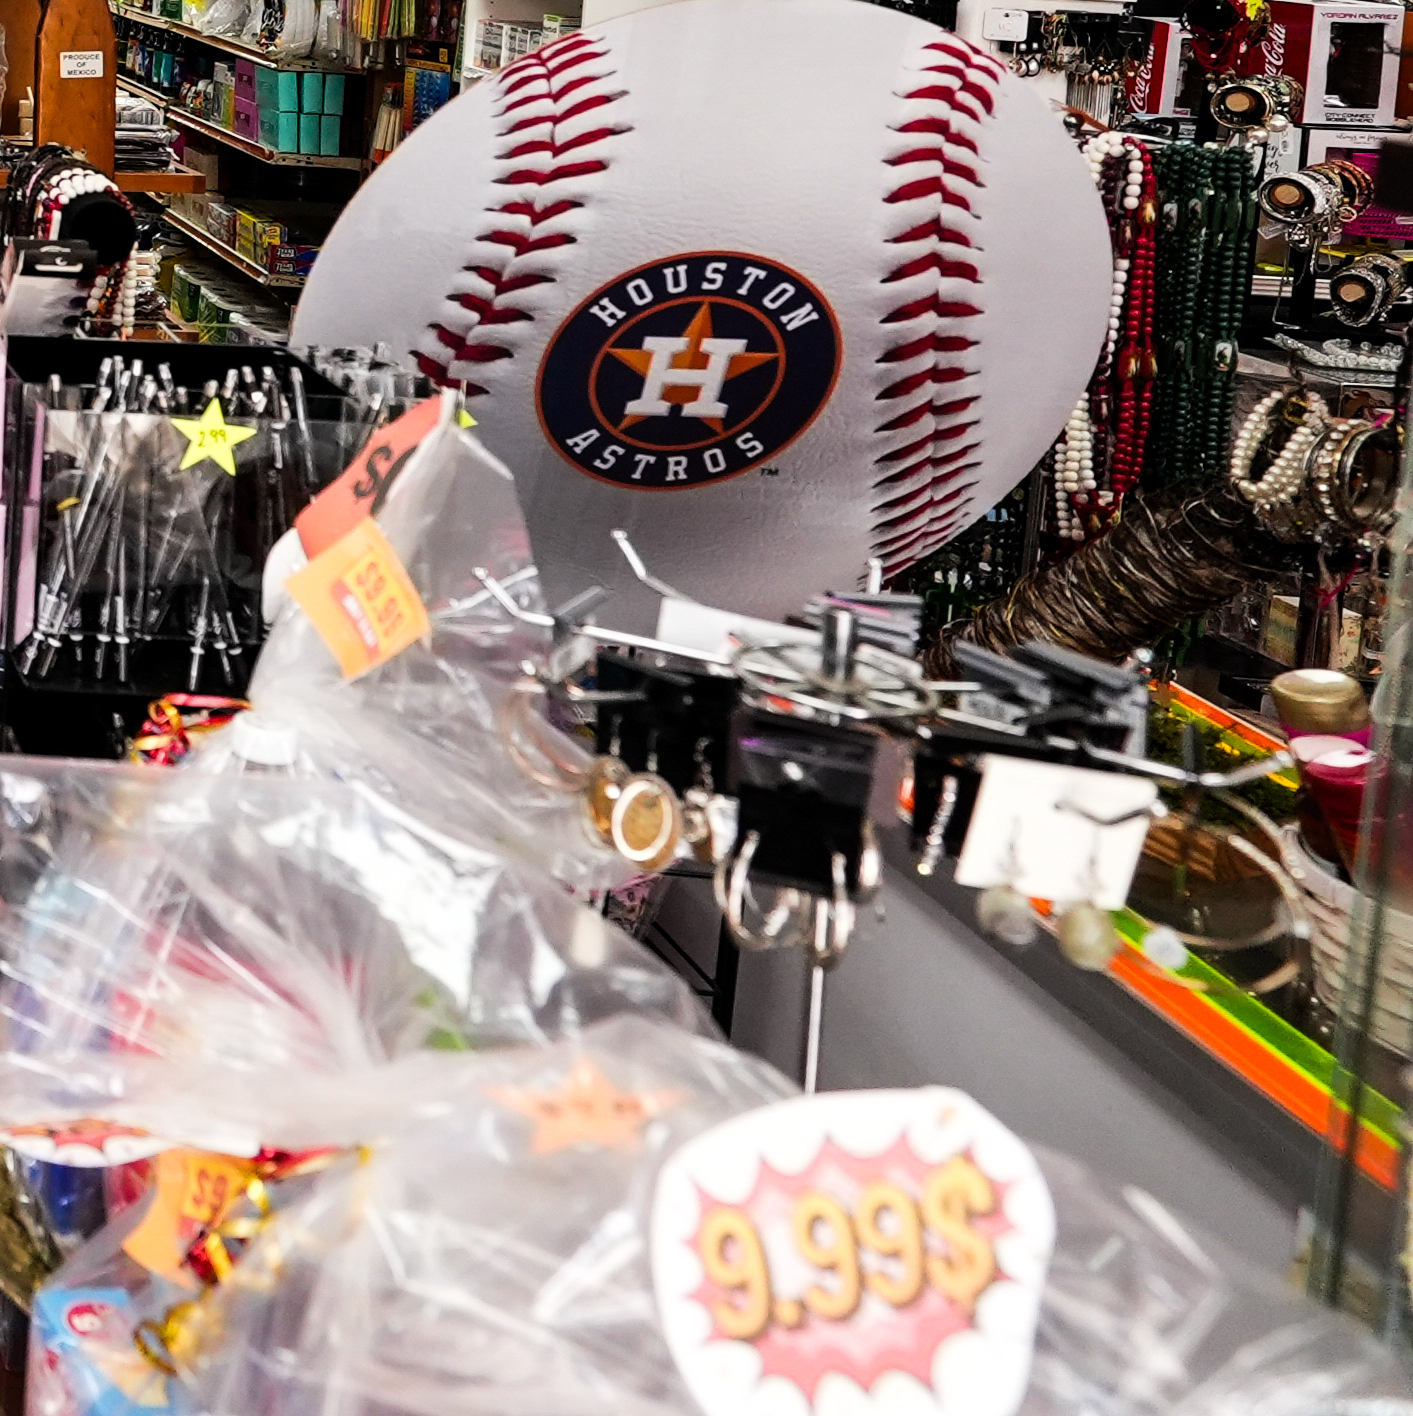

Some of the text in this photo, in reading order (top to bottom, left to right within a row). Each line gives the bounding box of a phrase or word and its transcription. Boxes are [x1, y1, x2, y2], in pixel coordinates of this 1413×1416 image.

[62, 52, 101, 63] PRODUCE
[66, 67, 99, 77] MEXICO
[588, 261, 821, 333] HOUSTON
[624, 335, 749, 419] H
[565, 431, 765, 482] ASTROS
[697, 1154, 999, 1342] 9.99$
